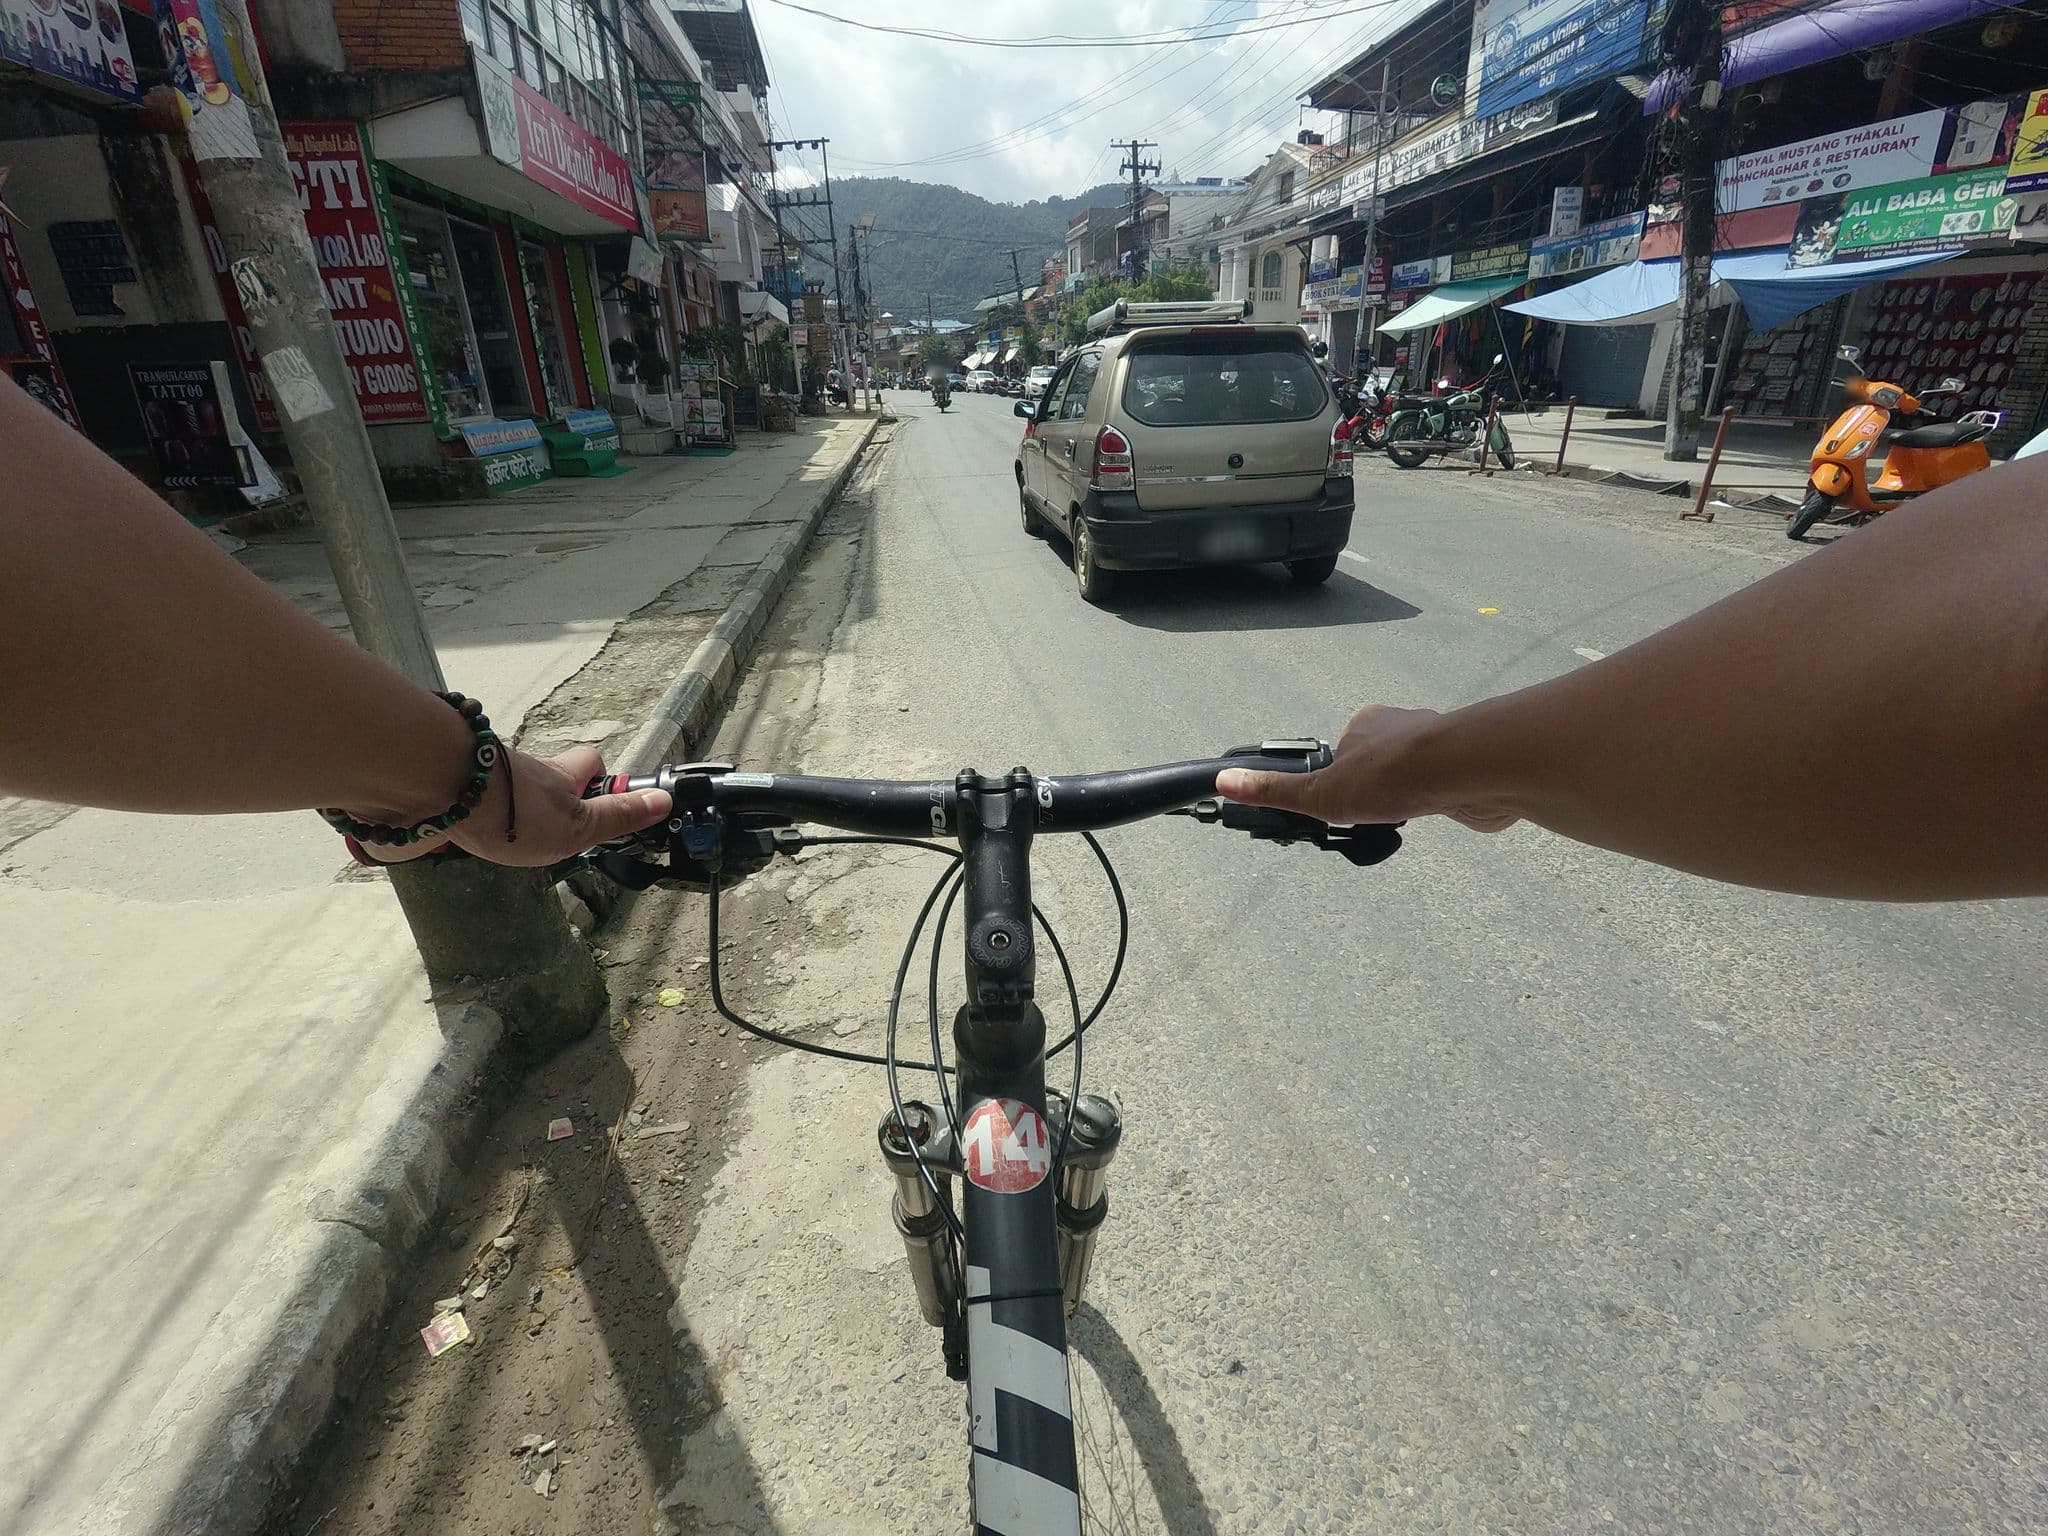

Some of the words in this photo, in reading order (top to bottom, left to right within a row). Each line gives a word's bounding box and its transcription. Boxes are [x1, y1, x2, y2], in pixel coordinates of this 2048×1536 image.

[1362, 158, 1391, 182] VALEY
[1391, 131, 1449, 171] RESTAURANT
[1461, 120, 1480, 141] BAR
[1738, 154, 1775, 171] ROYAL
[1777, 138, 1841, 163] MUSTANG
[1844, 123, 1905, 146] THAKALI
[1812, 157, 1822, 168] &
[1825, 135, 1920, 166] RESTAURANT
[370, 163, 395, 247] SOLAR
[1846, 198, 1882, 218] ALI
[1886, 187, 1947, 212] BABA
[345, 219, 386, 267] LAB
[1510, 252, 1528, 267] SHOP
[1305, 289, 1322, 300] BOOK
[331, 318, 404, 357] TUDIO
[149, 384, 205, 400] TATTOO
[362, 363, 418, 395] GOODS
[962, 1111, 1047, 1177] 14
